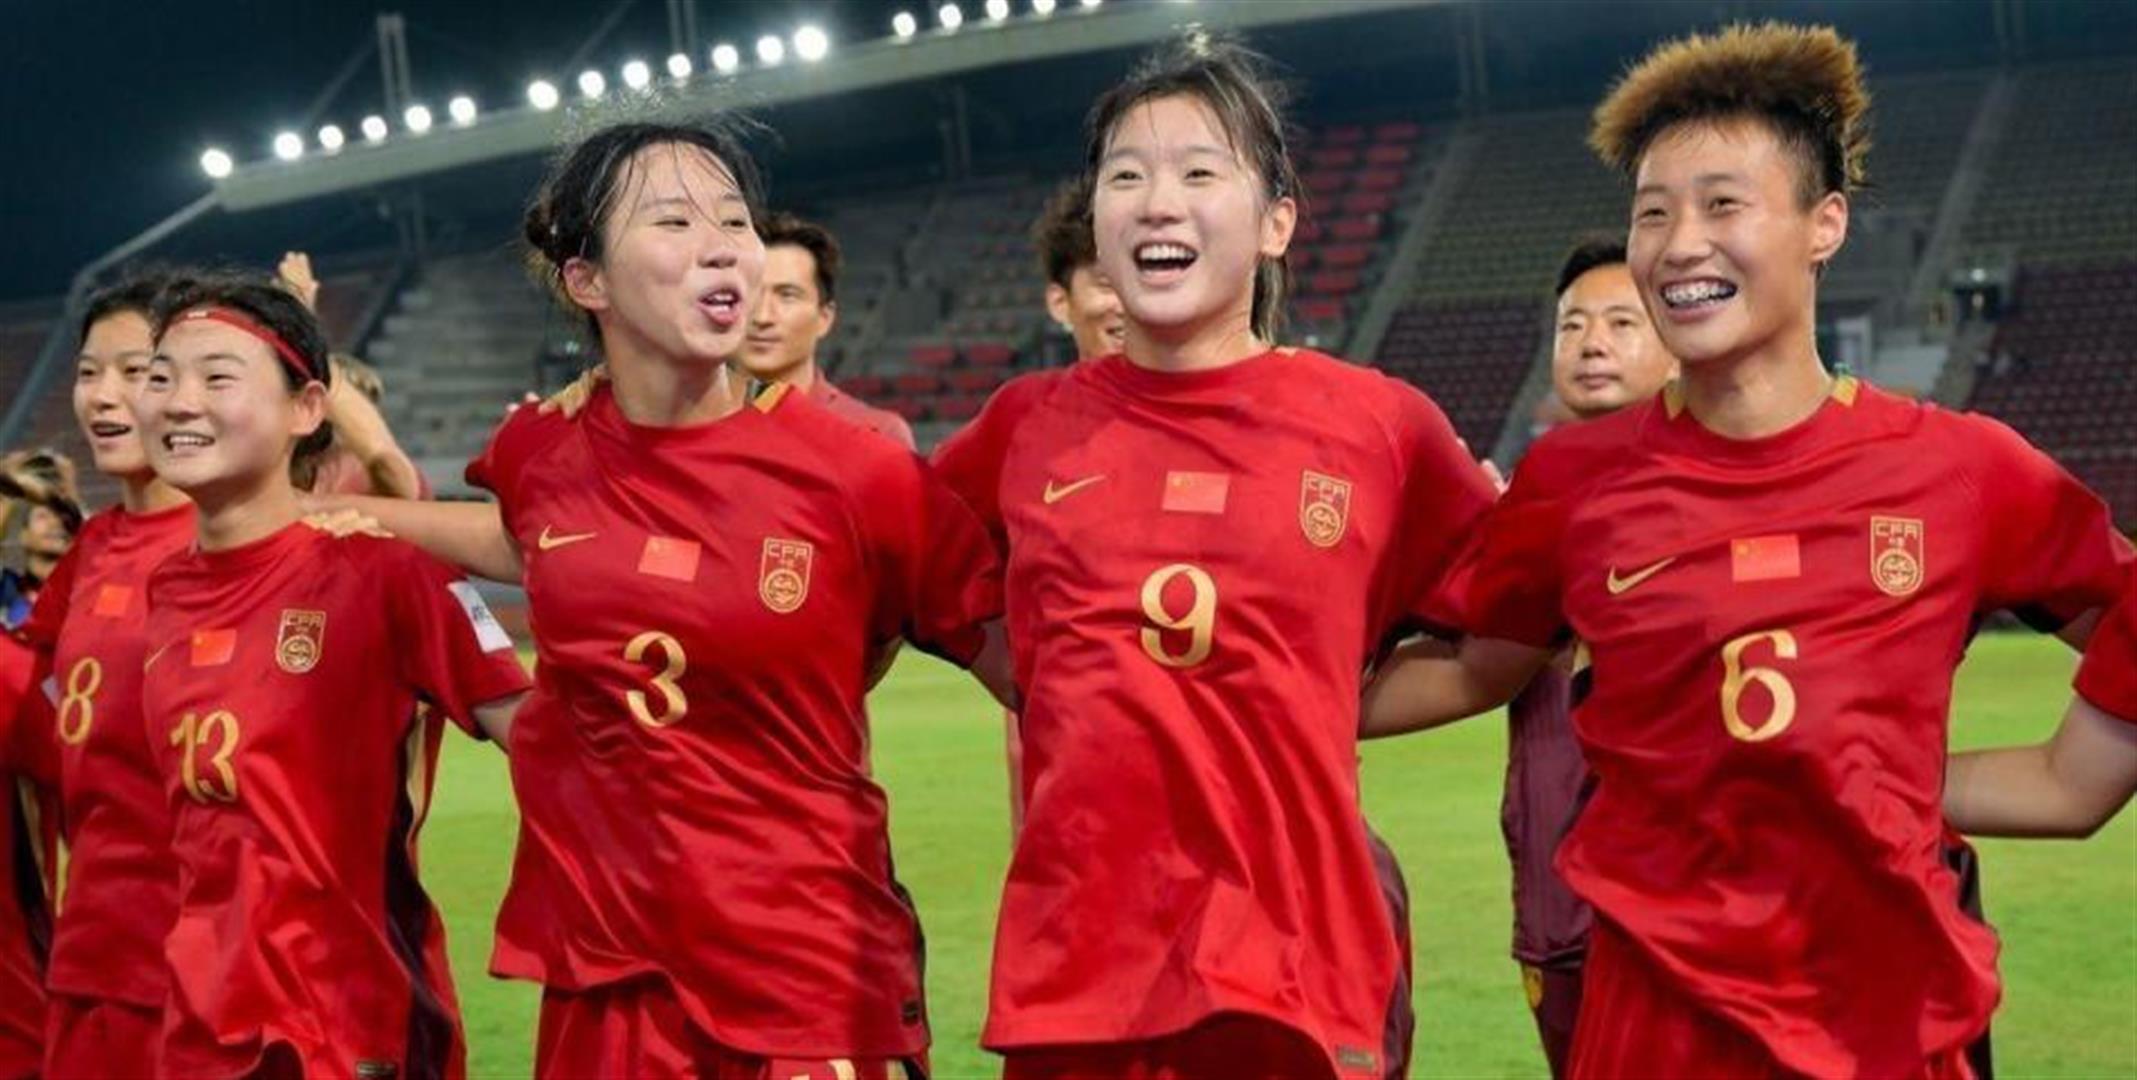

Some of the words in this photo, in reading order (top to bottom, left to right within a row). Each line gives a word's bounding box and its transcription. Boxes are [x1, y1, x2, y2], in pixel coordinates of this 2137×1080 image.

[1141, 564, 1217, 667] 9
[60, 657, 101, 744] 8
[624, 631, 688, 727] 3
[1722, 629, 1798, 741] 6
[170, 710, 239, 802] 13
